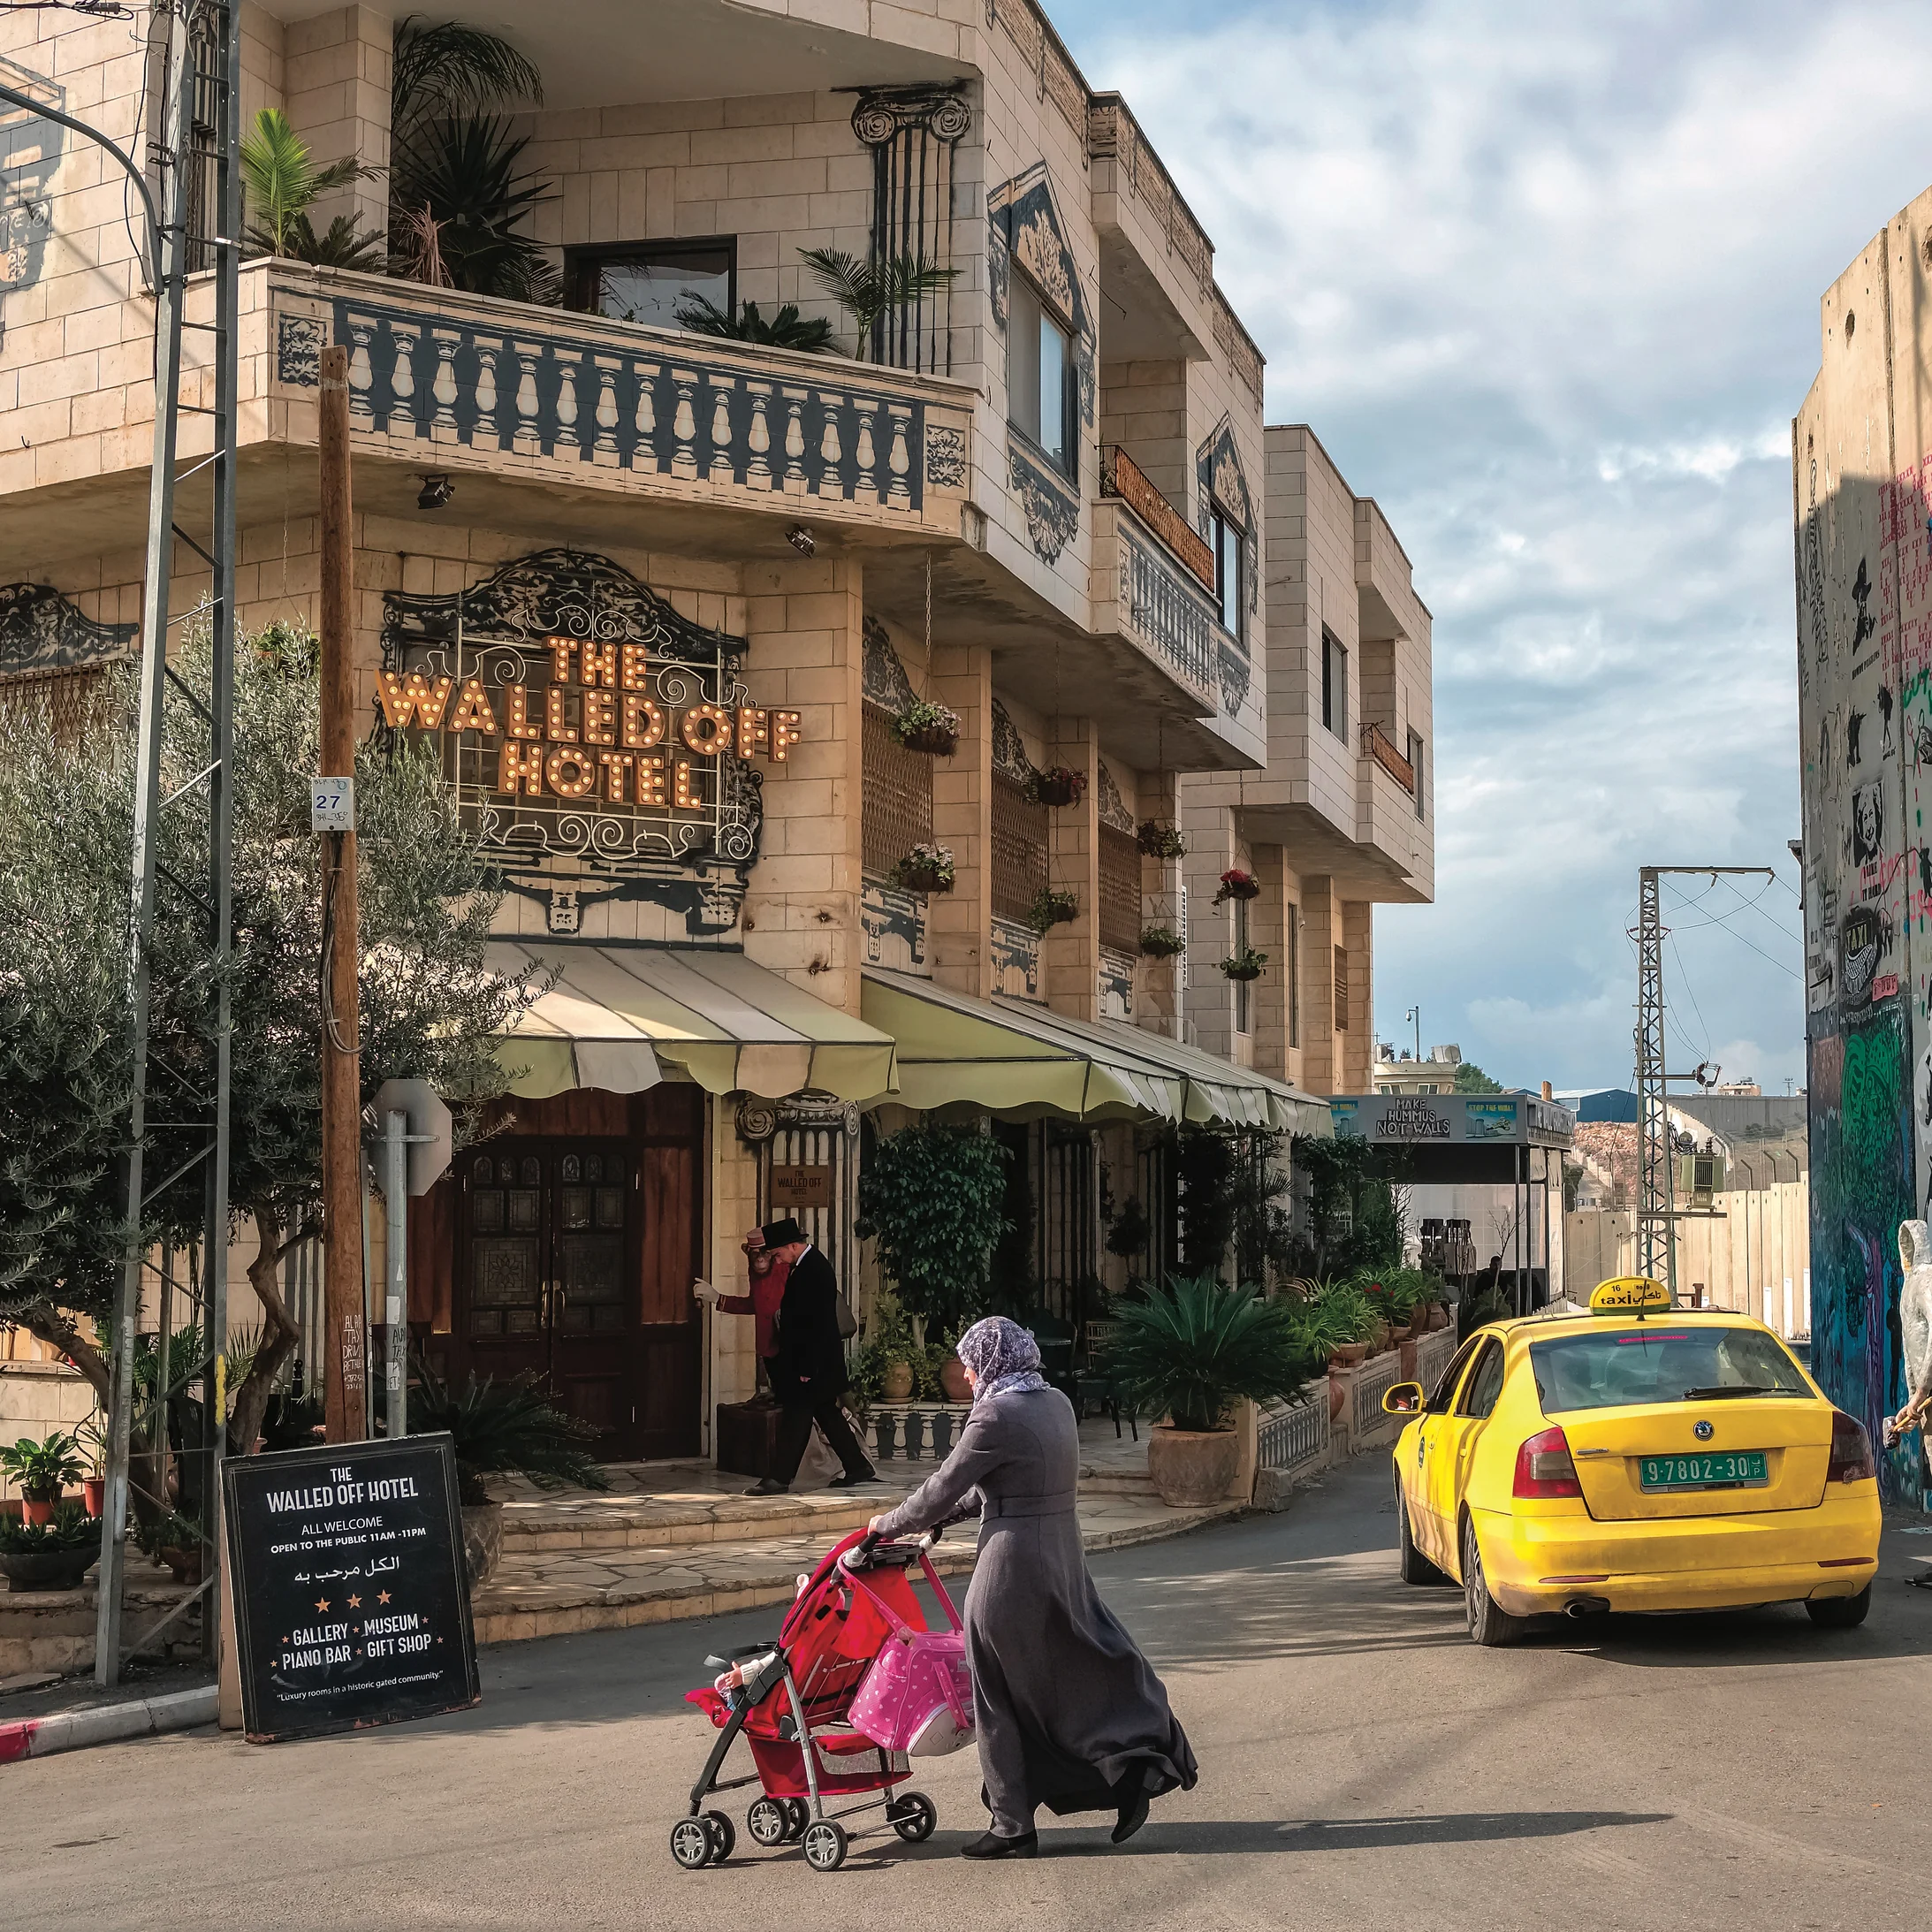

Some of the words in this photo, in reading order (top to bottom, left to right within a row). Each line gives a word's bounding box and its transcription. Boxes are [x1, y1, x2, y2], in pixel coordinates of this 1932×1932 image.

[542, 636, 647, 691] THE
[374, 668, 666, 749] WALLED
[677, 703, 802, 763] OFF
[498, 740, 702, 810] HOTEL
[316, 795, 340, 810] 27
[1846, 924, 1867, 952] TAXI
[1396, 1099, 1426, 1109] MAKE
[1388, 1110, 1436, 1122] HUMMUS
[1377, 1121, 1408, 1135] NOT
[1413, 1120, 1449, 1134] WALLS
[778, 1177, 808, 1188] WALLED
[809, 1177, 822, 1188] OFF
[1601, 1291, 1632, 1304] taxi
[330, 1466, 353, 1482] THE
[1753, 1467, 1760, 1476] P
[267, 1486, 333, 1512] WALLED
[337, 1483, 364, 1504] OFF
[368, 1477, 418, 1502] HOTEL
[301, 1523, 323, 1535] ALL
[324, 1516, 383, 1533] WELCOME
[270, 1544, 298, 1554] OPEN
[300, 1541, 313, 1550] TO
[316, 1539, 333, 1548] THE
[335, 1534, 367, 1547] PUBLIC
[369, 1531, 396, 1542] 11AM
[315, 1566, 361, 1583] مرحب
[365, 1555, 399, 1577] الكل
[294, 1571, 310, 1584] به
[293, 1623, 348, 1647] GALLERY
[363, 1613, 419, 1636] MUSEUM
[282, 1649, 322, 1670] PIANO
[325, 1645, 352, 1663] BAR
[367, 1639, 394, 1658] GIFT
[398, 1634, 431, 1654] SHOP
[308, 1687, 331, 1697] rooms
[347, 1680, 375, 1692] historic
[376, 1677, 397, 1689] gated
